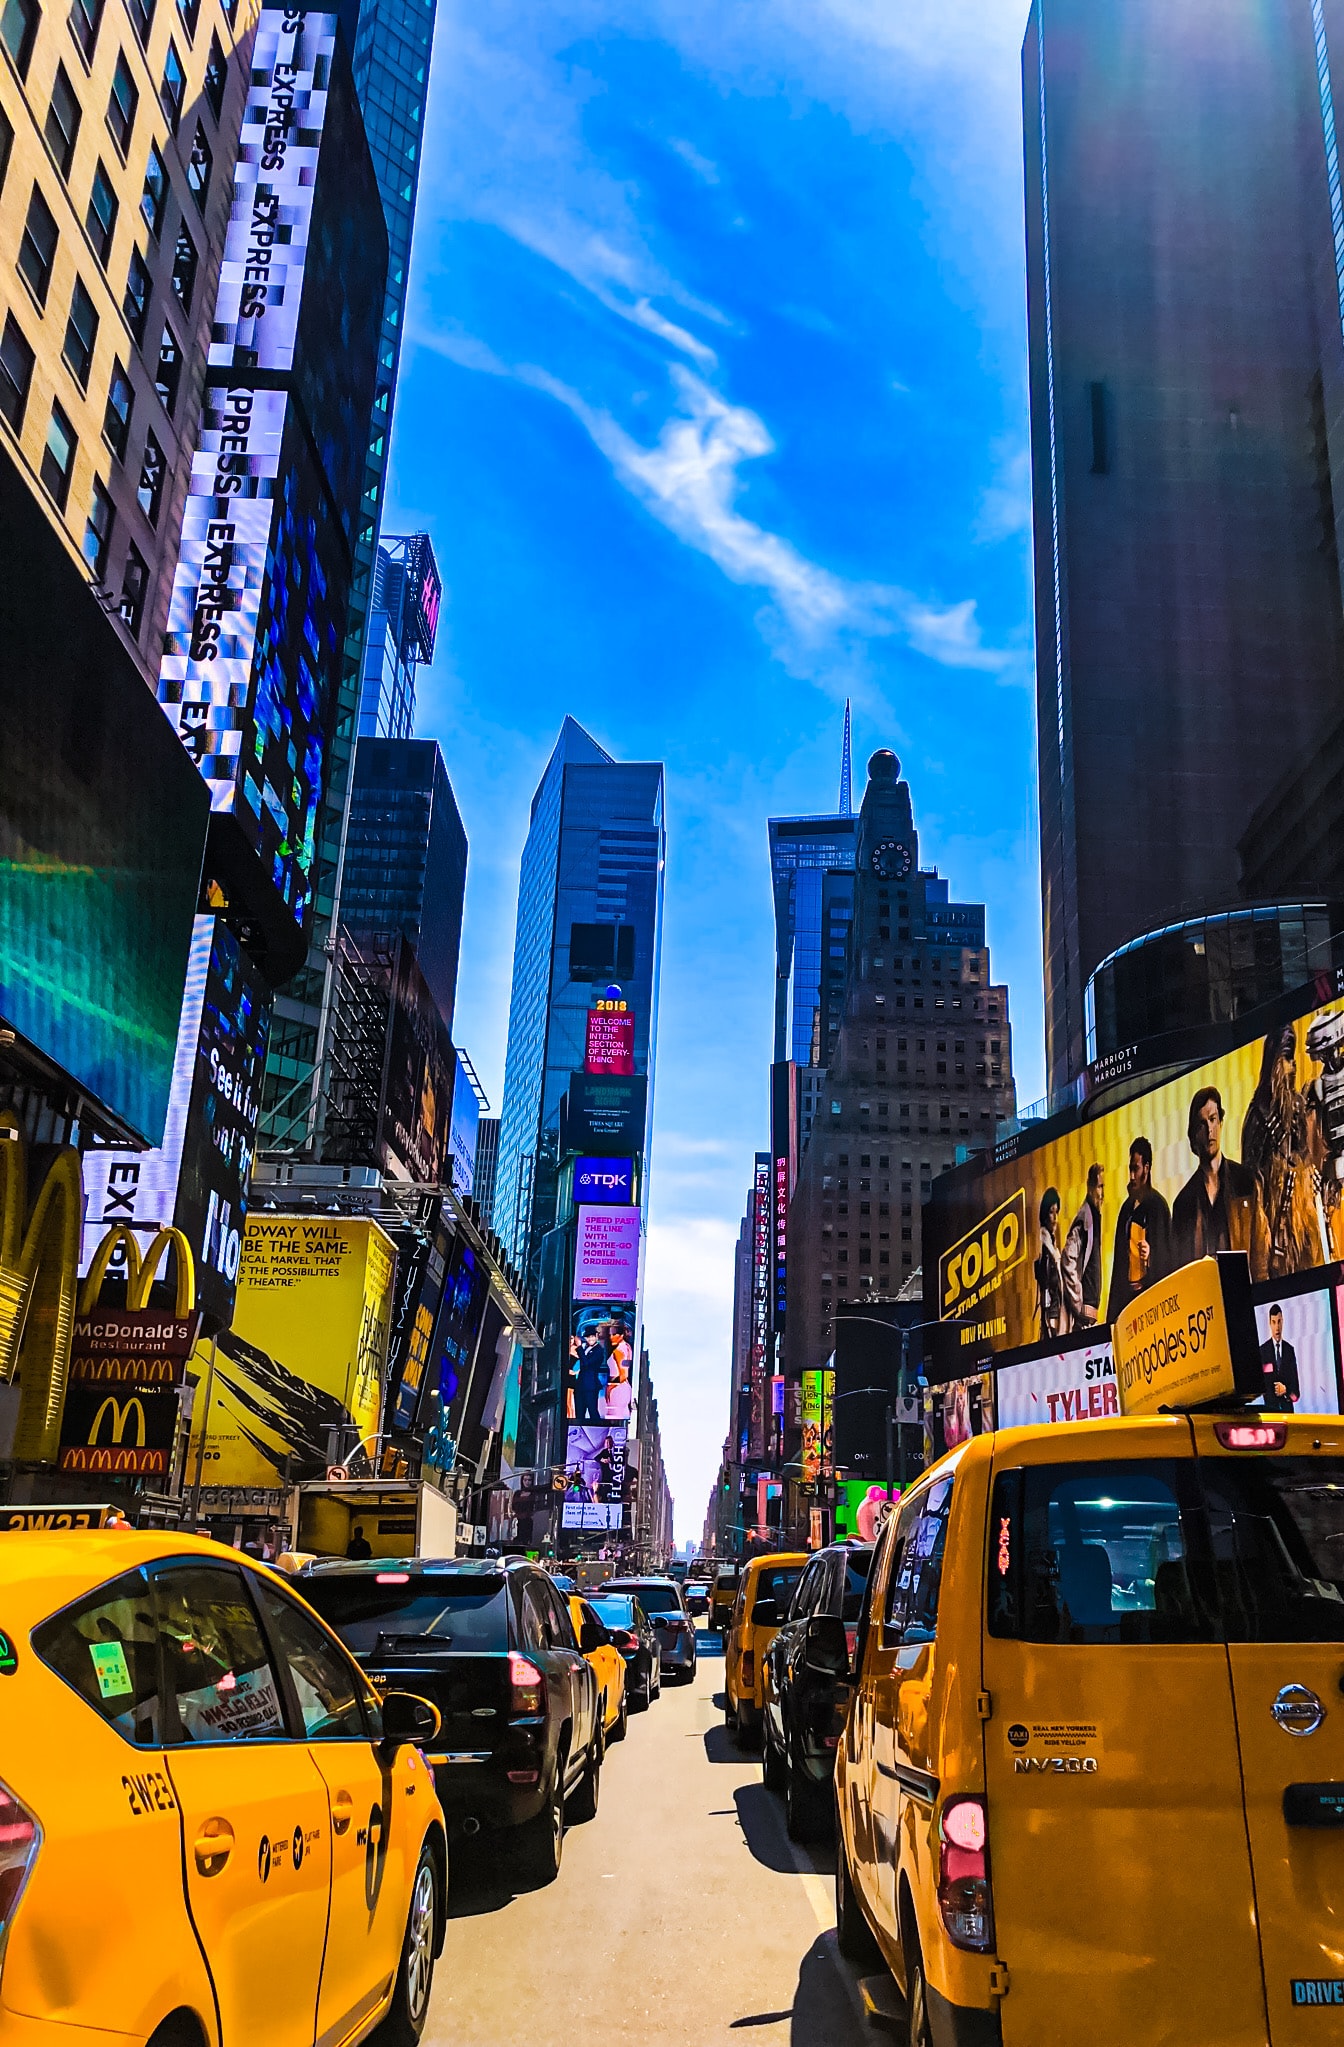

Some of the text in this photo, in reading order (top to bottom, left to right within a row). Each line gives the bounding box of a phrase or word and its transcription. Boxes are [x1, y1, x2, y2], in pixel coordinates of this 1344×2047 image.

[260, 62, 299, 172] EXPRESS
[238, 194, 280, 320] EXPRESS
[188, 522, 236, 663] EXPRESS
[596, 1000, 627, 1011] 2018
[590, 1017, 632, 1026] WELCOME
[604, 1025, 619, 1033] THE
[588, 1056, 615, 1064] THING.
[601, 1049, 630, 1057] EVERY-
[1094, 1045, 1138, 1072] MARRIOTT
[1094, 1060, 1132, 1084] MARQUIS
[995, 1137, 1020, 1154] MARRIOTT
[995, 1147, 1018, 1163] MARQUIS
[591, 1173, 627, 1187] TDK
[585, 1216, 636, 1225] SPEED PAST
[302, 1227, 342, 1240] WILL
[585, 1224, 623, 1233] THE LINE
[584, 1233, 608, 1241] WITH
[244, 1240, 352, 1255] BE THE SAME.
[583, 1241, 633, 1250] ON-THE-GO
[270, 1255, 311, 1265] MARVEL
[314, 1256, 342, 1265] THAT
[583, 1249, 616, 1257] MOBILE
[944, 1212, 1019, 1307] SOLO
[582, 1257, 630, 1266] ORDERING.
[249, 1266, 270, 1275] THE
[272, 1267, 340, 1277] POSSIBILITIES
[954, 1271, 1004, 1319] STAR WARS
[1144, 1304, 1160, 1328] NEW
[1159, 1293, 1181, 1318] YORK
[72, 1323, 189, 1339] McDonald's
[960, 1316, 1007, 1346] NOW PLAYING
[90, 1339, 167, 1351] Restaurant
[1046, 1382, 1119, 1423] TYLER
[611, 1431, 627, 1498] FLAGSHIP
[368, 1674, 387, 1684] eep
[1276, 1704, 1321, 1714] NISSAN
[1014, 1757, 1098, 1774] NV200
[121, 1772, 175, 1816] 2W23
